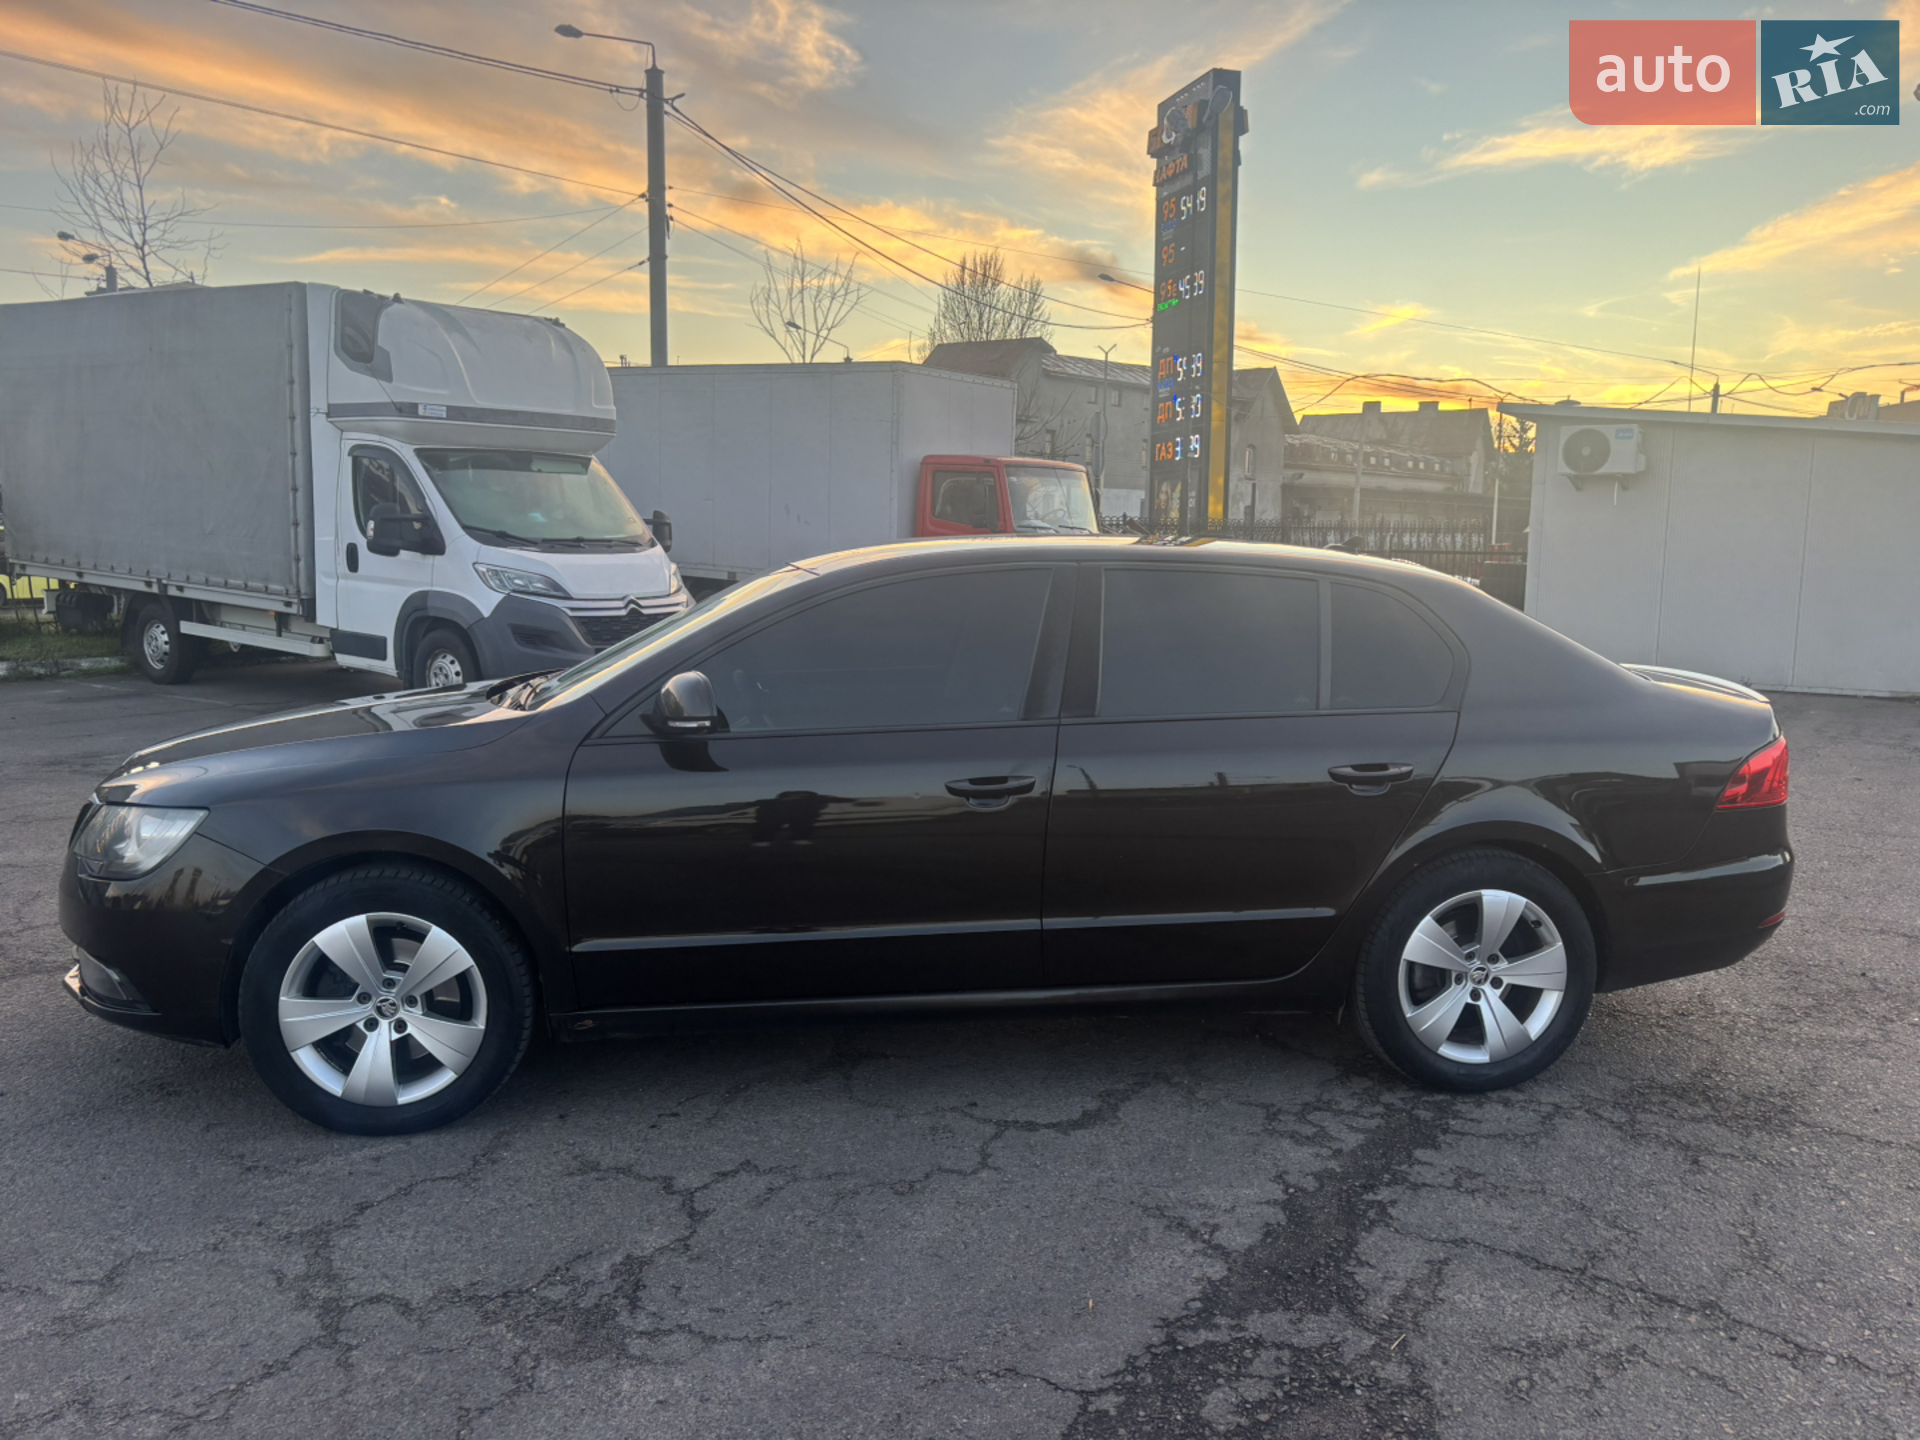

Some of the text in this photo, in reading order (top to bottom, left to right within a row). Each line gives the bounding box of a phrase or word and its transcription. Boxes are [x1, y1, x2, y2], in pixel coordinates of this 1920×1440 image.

[1162, 197, 1177, 222] 95
[1162, 243, 1176, 268] 95
[1157, 356, 1174, 382] ДП
[1157, 401, 1173, 424] ДП
[1155, 442, 1174, 461] ГАЗ
